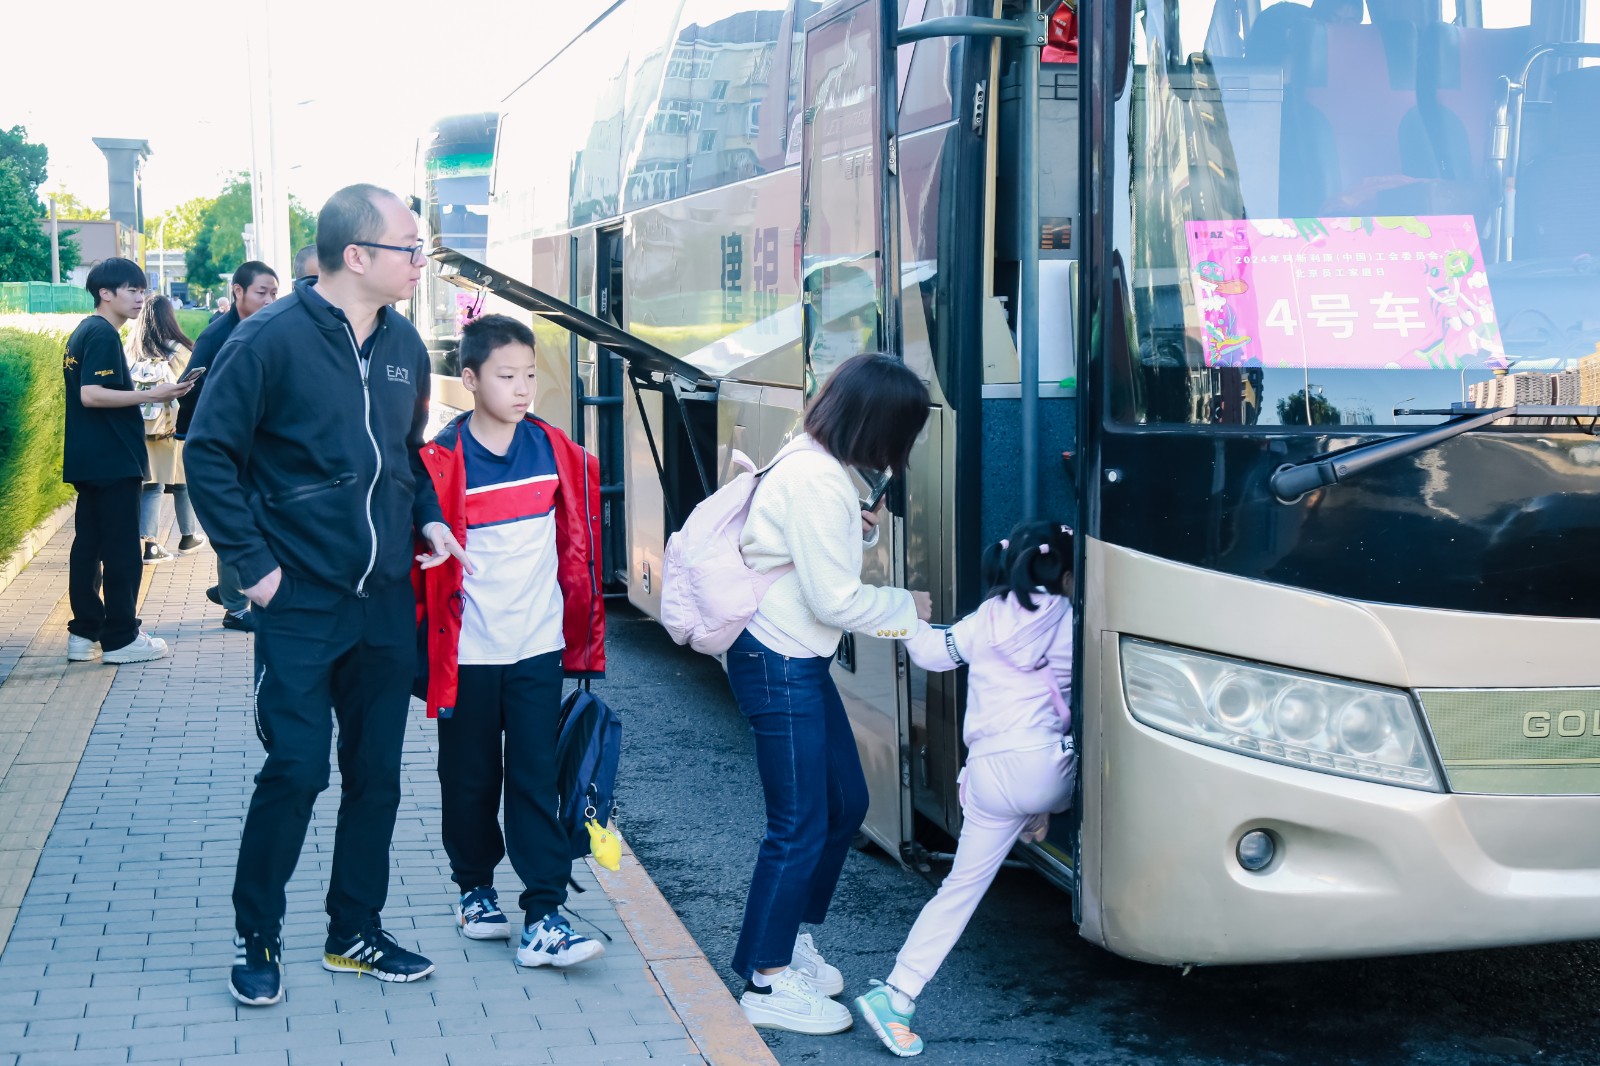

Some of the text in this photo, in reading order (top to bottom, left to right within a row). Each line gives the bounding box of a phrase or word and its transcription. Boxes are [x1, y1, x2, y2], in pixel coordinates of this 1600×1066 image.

[1296, 267, 1385, 279] 北京员工家庭日
[1265, 291, 1427, 339] 4号车
